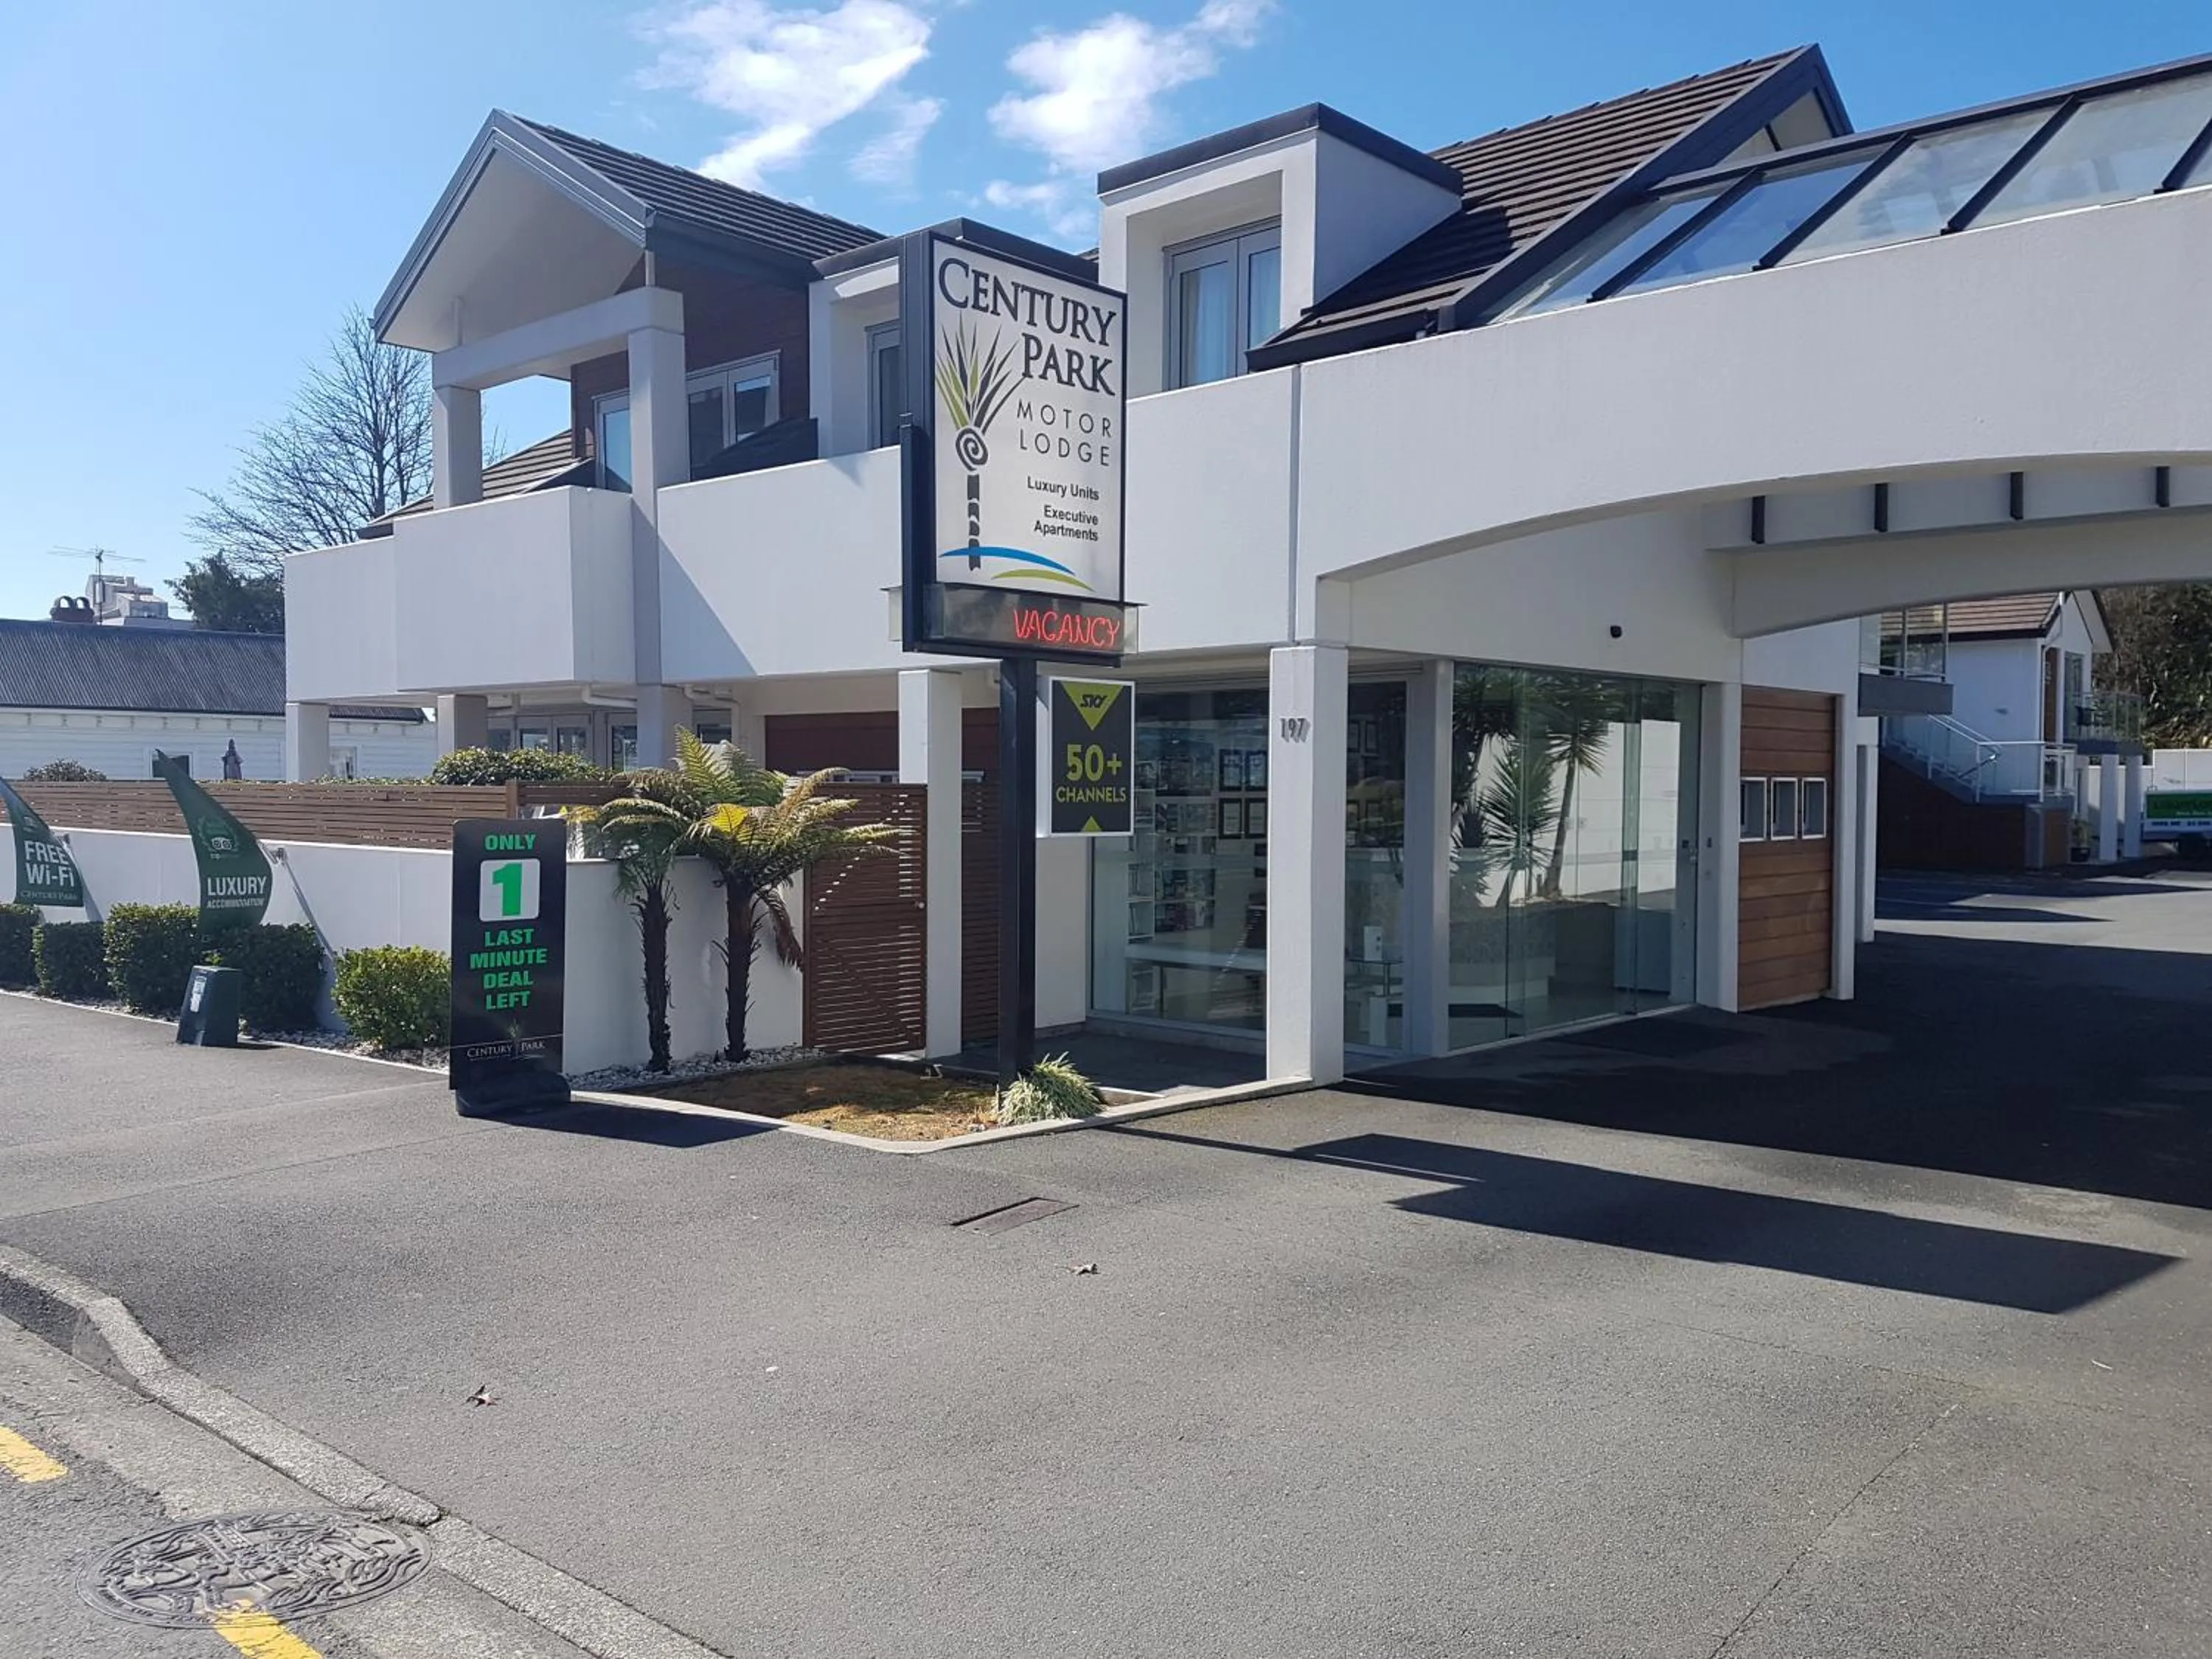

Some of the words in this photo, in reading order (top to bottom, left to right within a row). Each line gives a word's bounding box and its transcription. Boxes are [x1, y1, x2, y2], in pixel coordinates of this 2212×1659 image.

[938, 257, 1117, 347] CENTURY
[1020, 332, 1116, 396] PARK
[1017, 398, 1112, 438] MOTOR
[1020, 428, 1110, 467] LODGE
[1027, 476, 1067, 498] Luxury
[1070, 483, 1100, 501] Units
[1044, 504, 1099, 526] Executive
[1034, 520, 1099, 541] Apartments
[1012, 608, 1121, 647] VACANCY
[1080, 694, 1107, 709] SKY
[1280, 717, 1307, 738] 197
[1066, 743, 1122, 782] 50+
[1056, 786, 1127, 804] CHANNELS
[24, 841, 70, 865] FREE
[484, 834, 537, 850] ONLY
[25, 863, 75, 887] Wi-Fi
[207, 876, 267, 896] LUXURY
[492, 862, 523, 917] 1
[484, 928, 535, 947] LAST
[470, 948, 549, 970] MINUTE
[483, 971, 534, 989] DEAL
[486, 991, 531, 1010] LEFT
[467, 1044, 512, 1058] CENTURY
